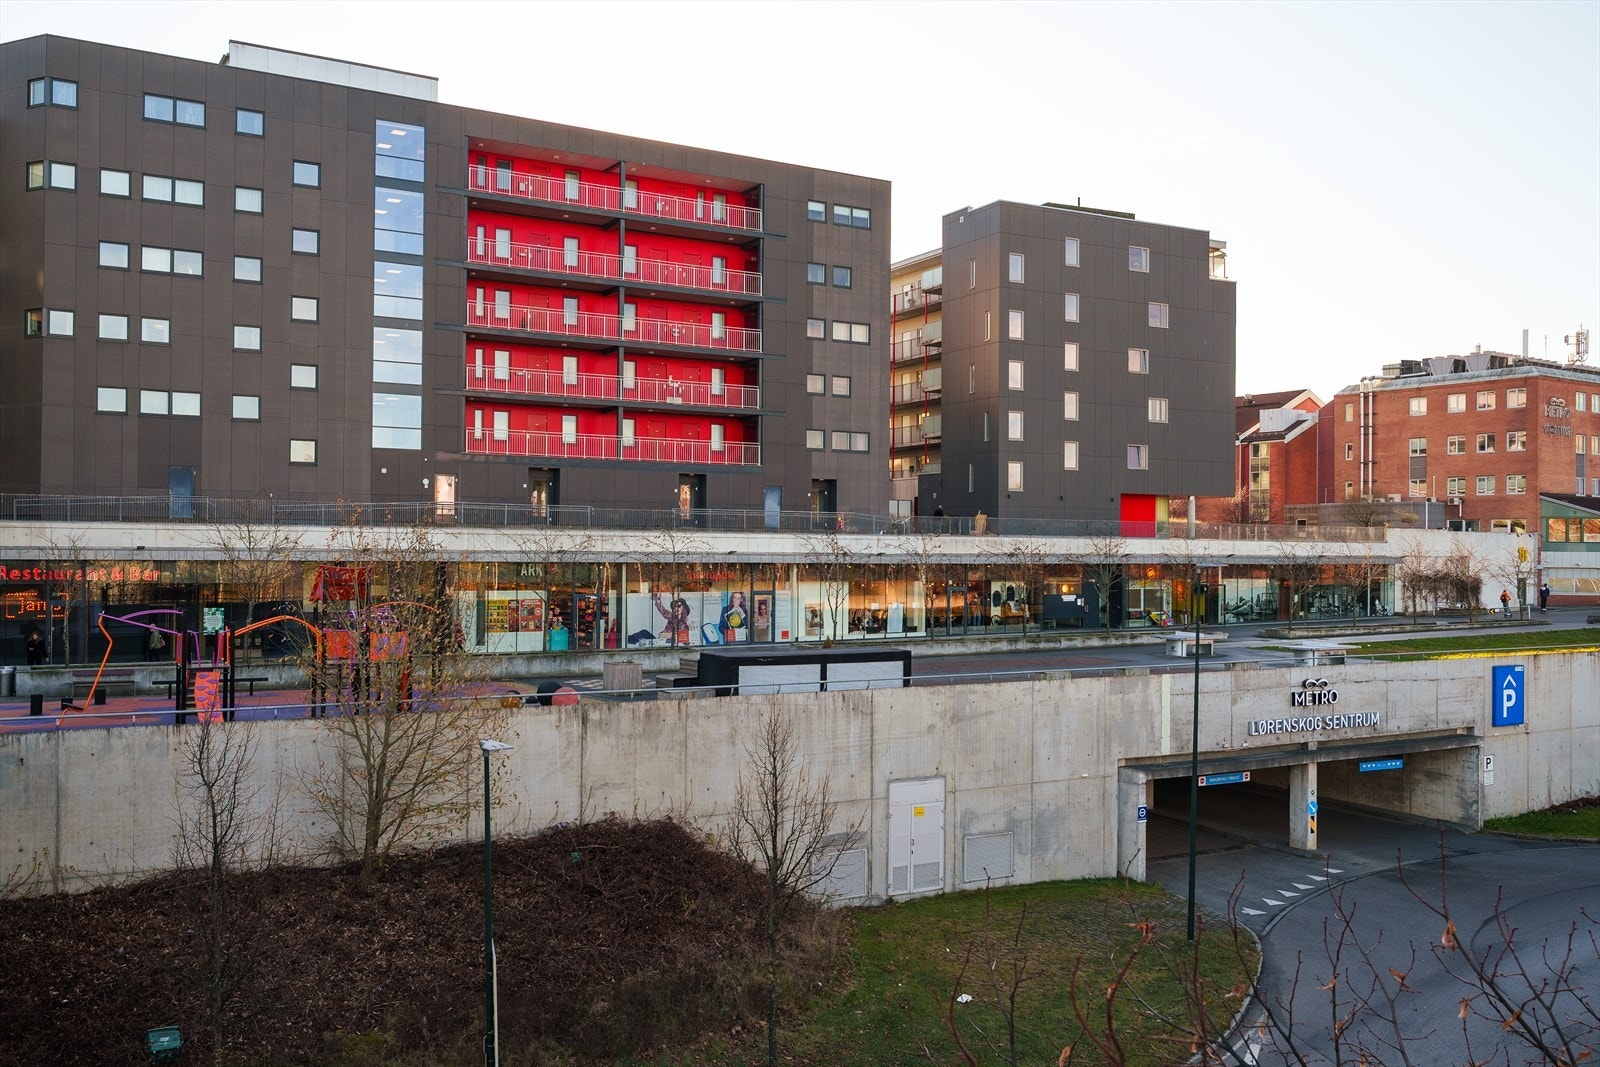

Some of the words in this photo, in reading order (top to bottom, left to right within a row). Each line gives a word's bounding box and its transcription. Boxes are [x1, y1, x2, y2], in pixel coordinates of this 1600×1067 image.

[1544, 405, 1571, 419] METRO
[0, 565, 107, 581] Restaurant
[110, 566, 124, 581] &
[129, 566, 161, 581] Bar
[520, 563, 543, 577] ARK
[1293, 688, 1339, 707] METRO
[1502, 688, 1517, 718] P
[1251, 716, 1322, 736] LØRENSKOG
[1325, 711, 1381, 730] SENTRUM
[1485, 757, 1492, 770] P
